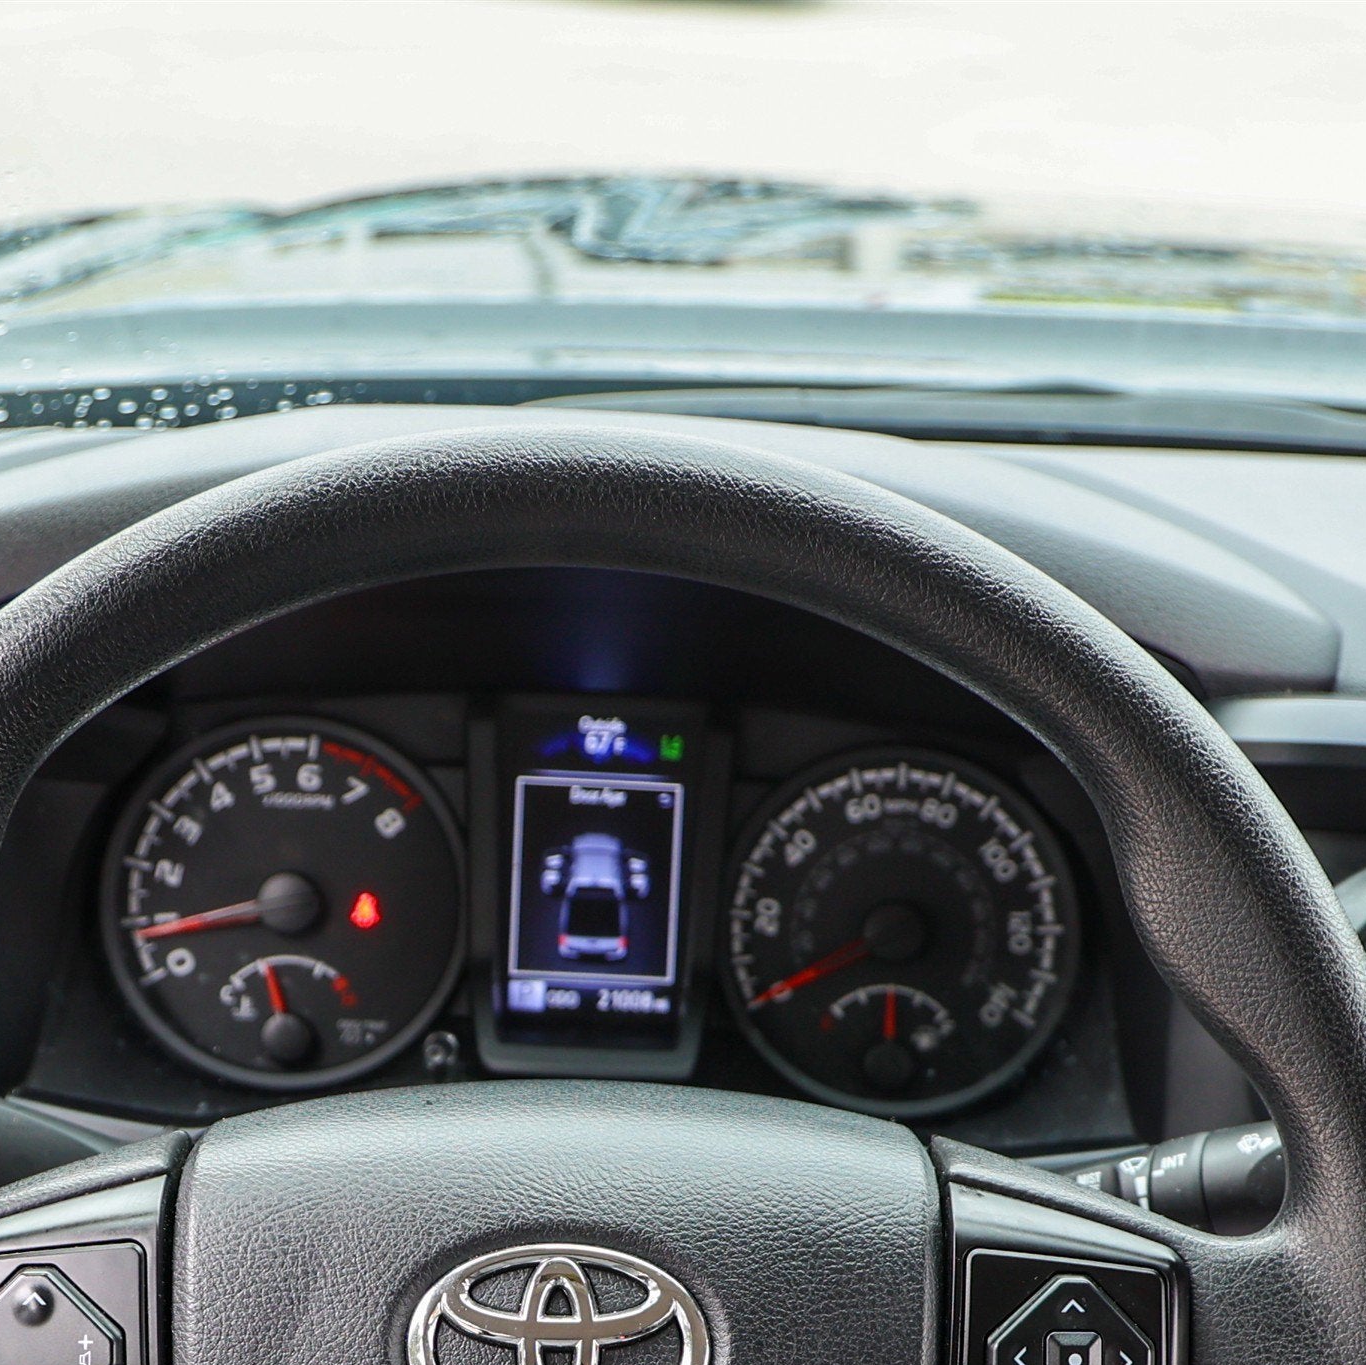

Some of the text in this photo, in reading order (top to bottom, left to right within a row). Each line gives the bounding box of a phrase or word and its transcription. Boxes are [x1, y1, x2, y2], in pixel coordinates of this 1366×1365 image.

[249, 764, 276, 794] 5
[296, 764, 323, 792] 6
[341, 776, 371, 805] 7
[210, 781, 236, 813] 4
[844, 793, 883, 825] 60
[374, 807, 406, 839] 8
[920, 797, 958, 829] 80
[173, 815, 203, 845] 3
[783, 828, 817, 867] 40
[153, 859, 186, 889] 2
[754, 897, 782, 938] 20
[166, 948, 196, 978] 0
